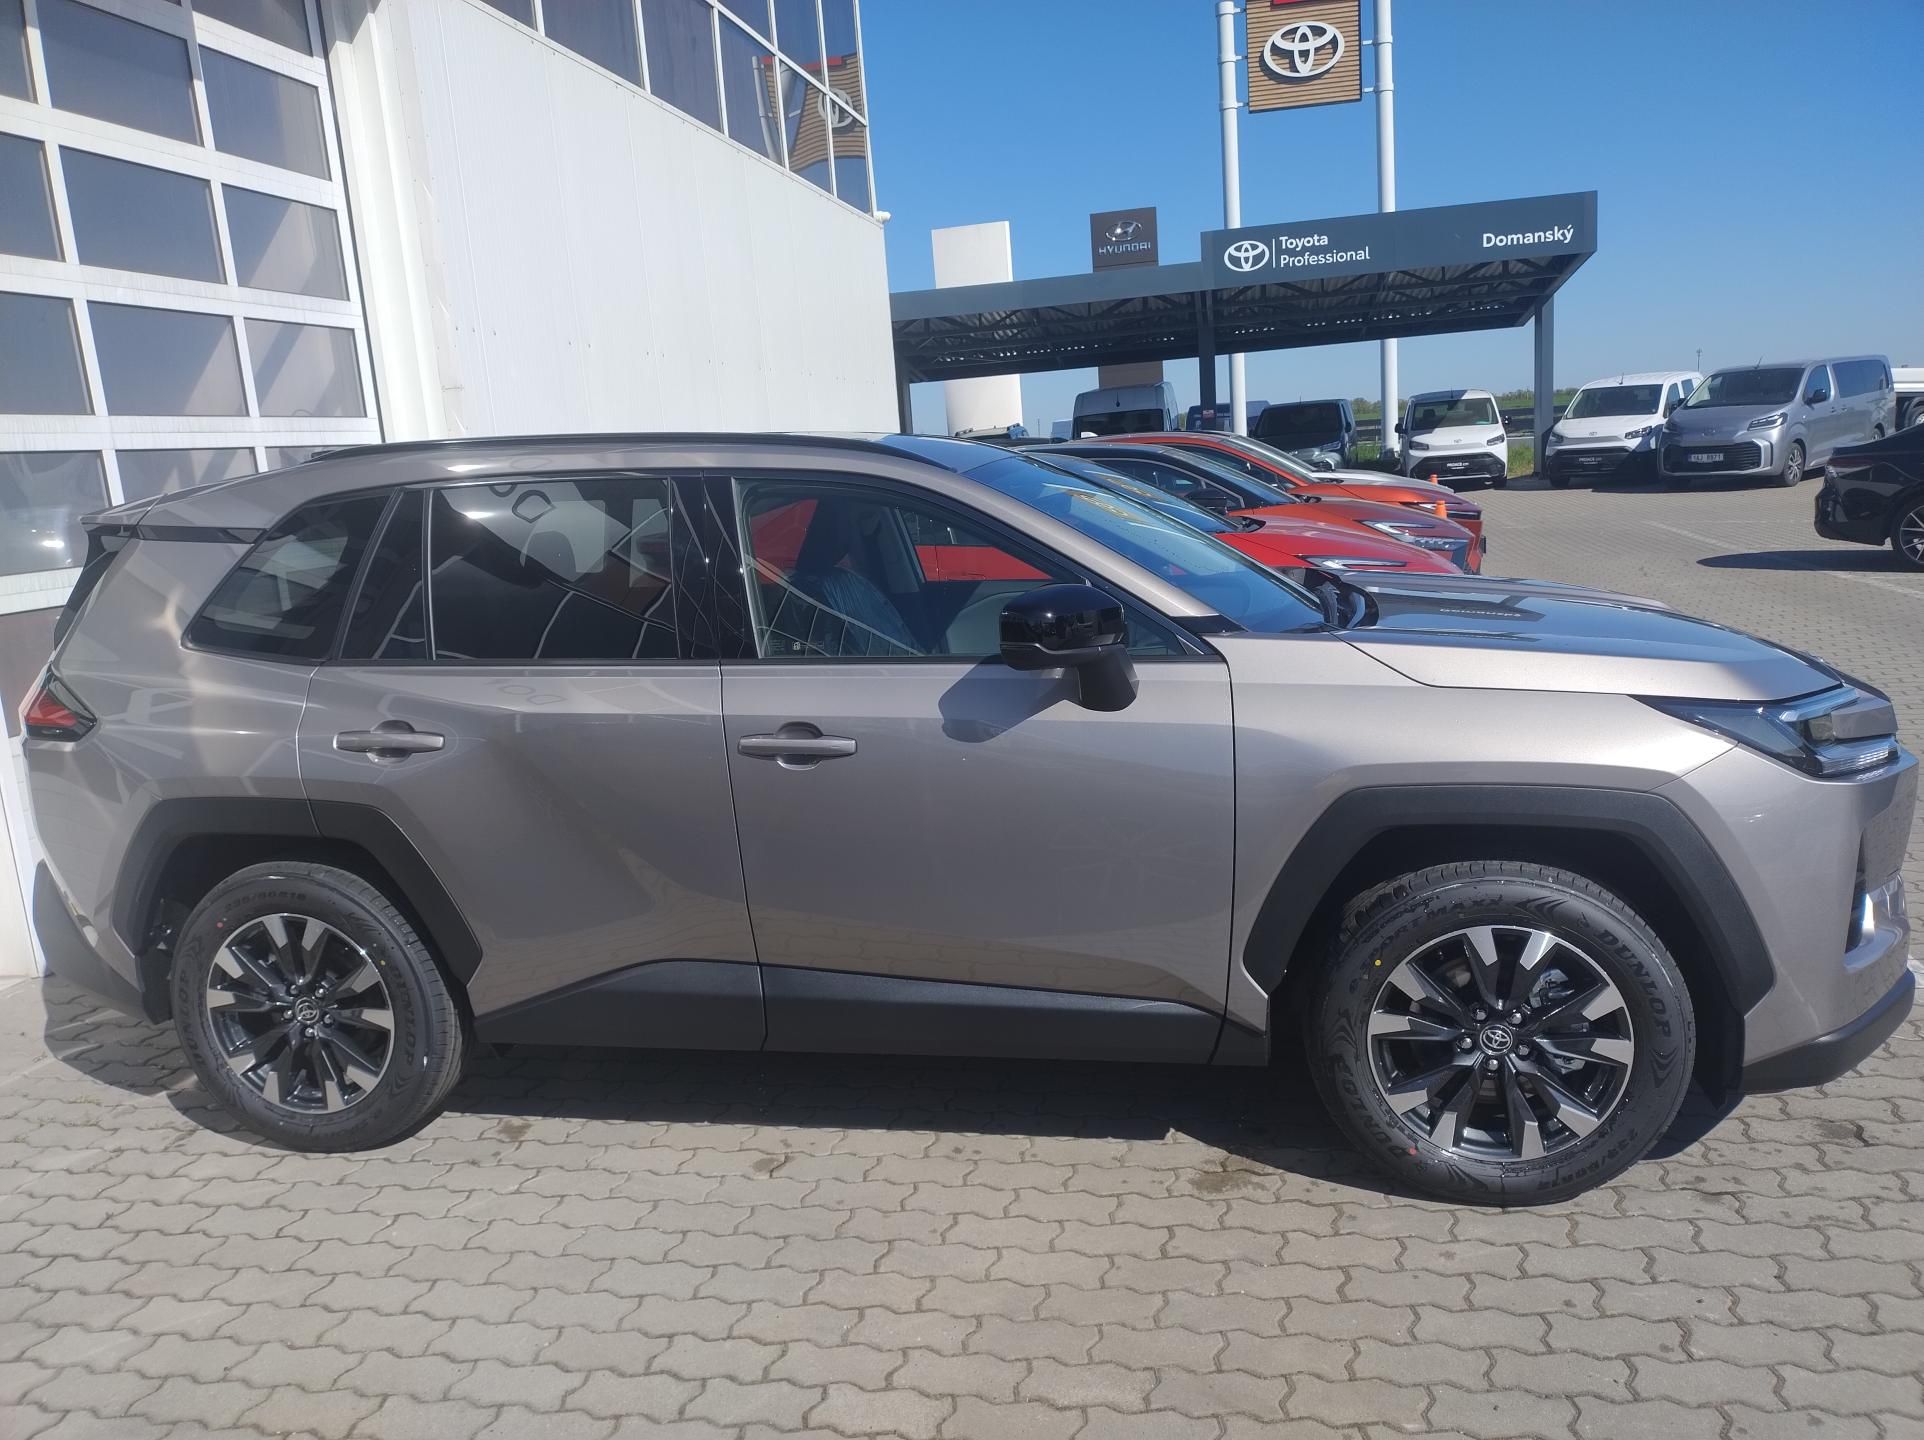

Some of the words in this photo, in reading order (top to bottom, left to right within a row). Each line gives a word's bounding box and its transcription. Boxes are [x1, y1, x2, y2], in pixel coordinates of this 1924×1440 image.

[1279, 234, 1329, 251] Toyota
[1482, 224, 1574, 248] Domanský
[1280, 245, 1371, 268] Professional
[1593, 928, 1673, 1038] DUNLOP
